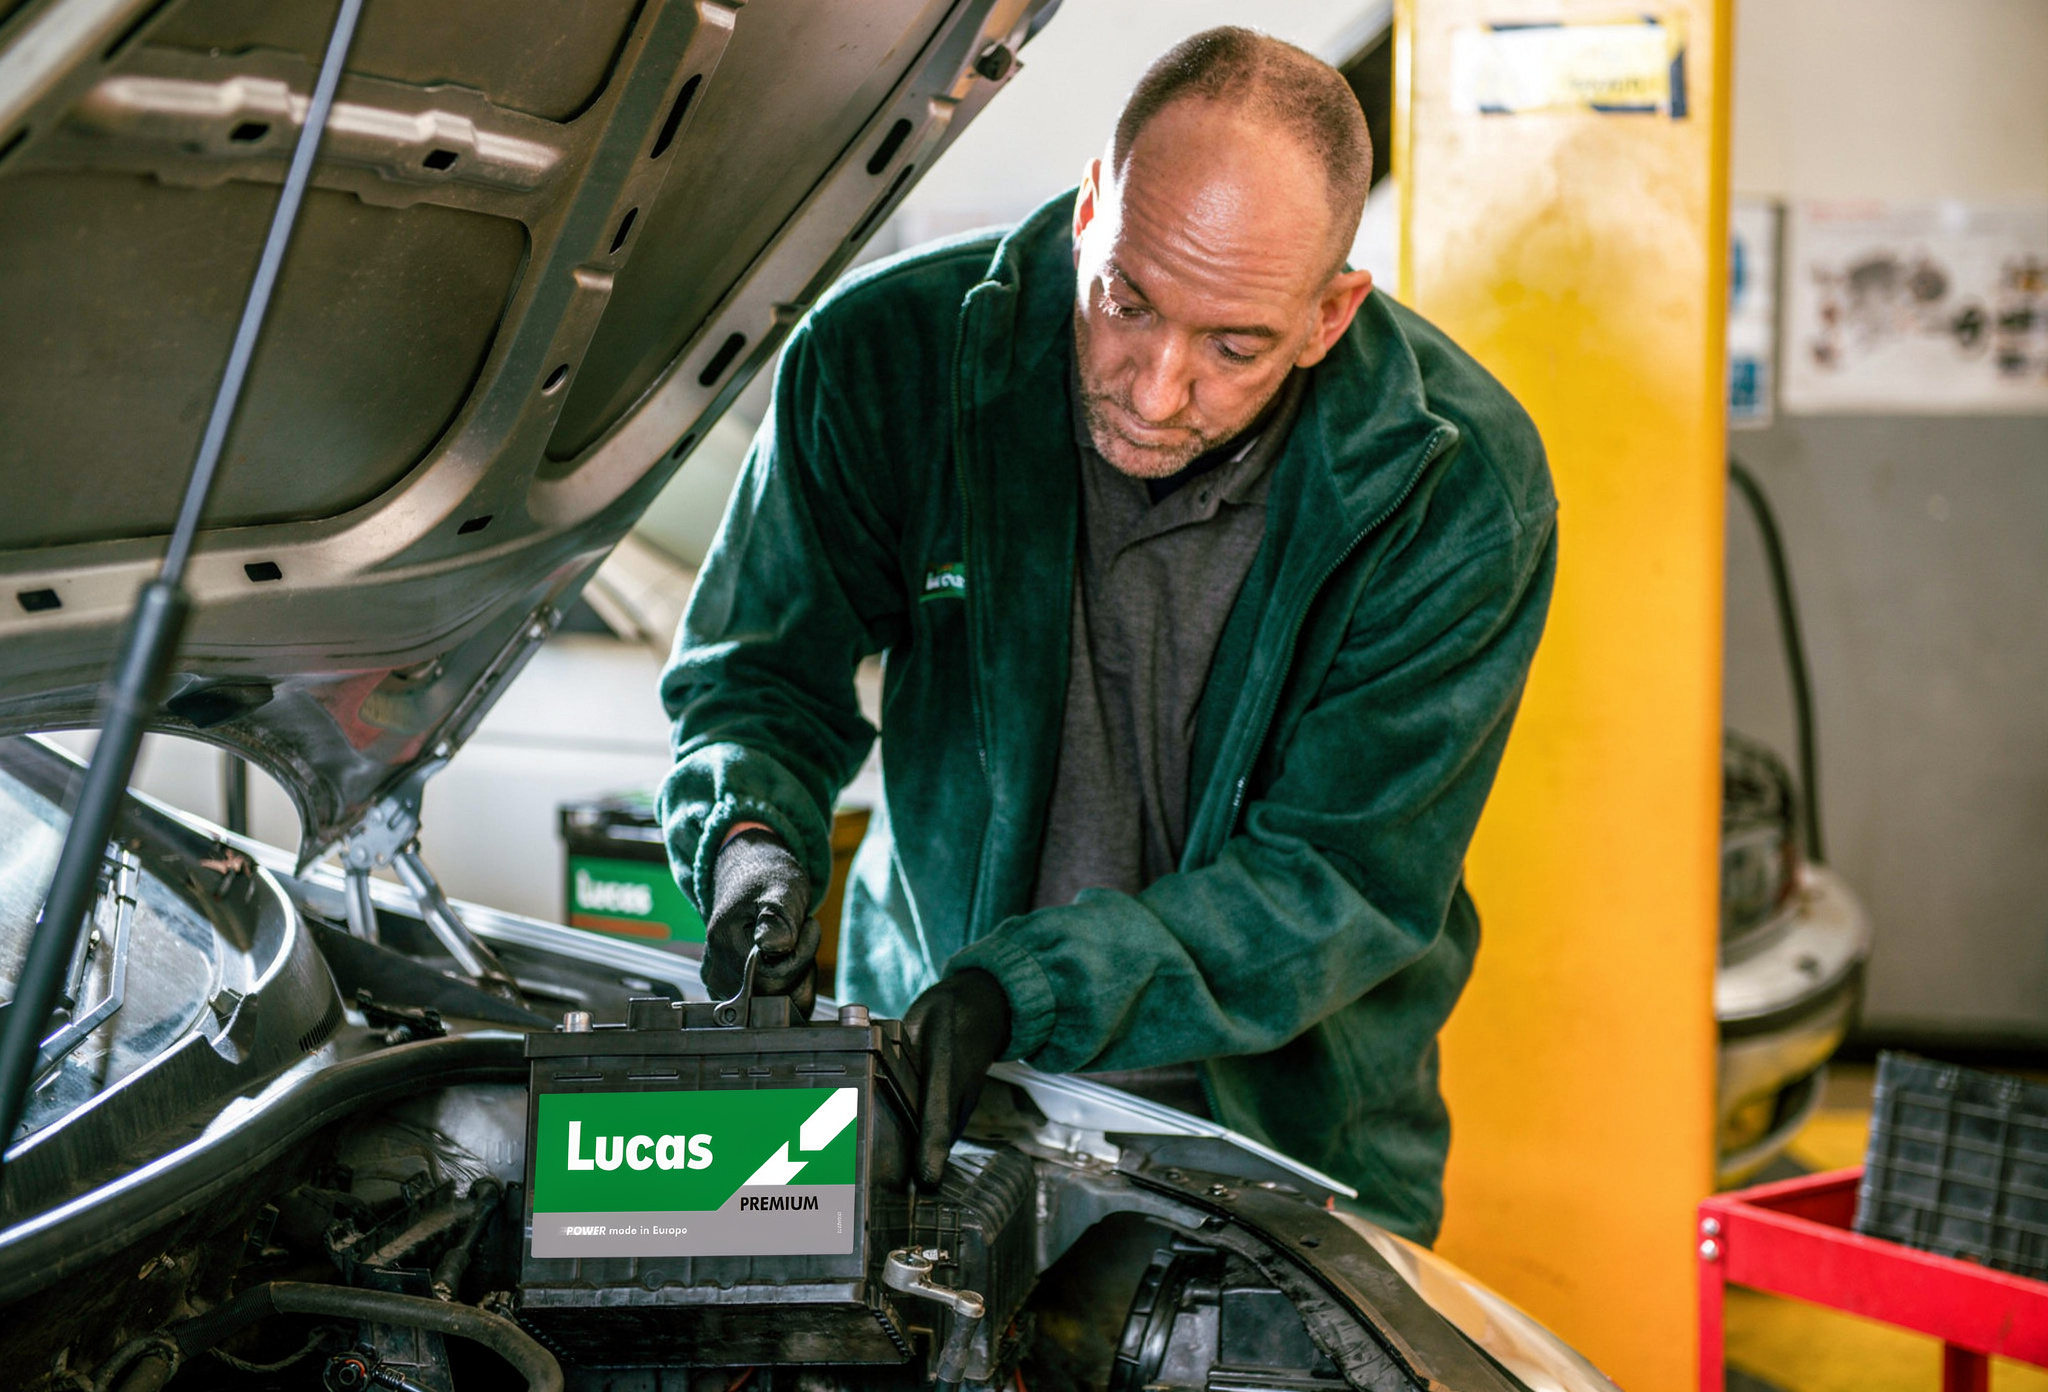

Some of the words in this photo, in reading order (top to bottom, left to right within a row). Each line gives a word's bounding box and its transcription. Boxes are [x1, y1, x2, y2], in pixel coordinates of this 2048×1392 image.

[567, 1120, 714, 1171] Lucas
[740, 1196, 819, 1211] PREMIUM
[565, 1226, 607, 1236] POWER
[609, 1225, 637, 1235] made
[640, 1225, 650, 1235] in
[652, 1225, 688, 1238] Europe
